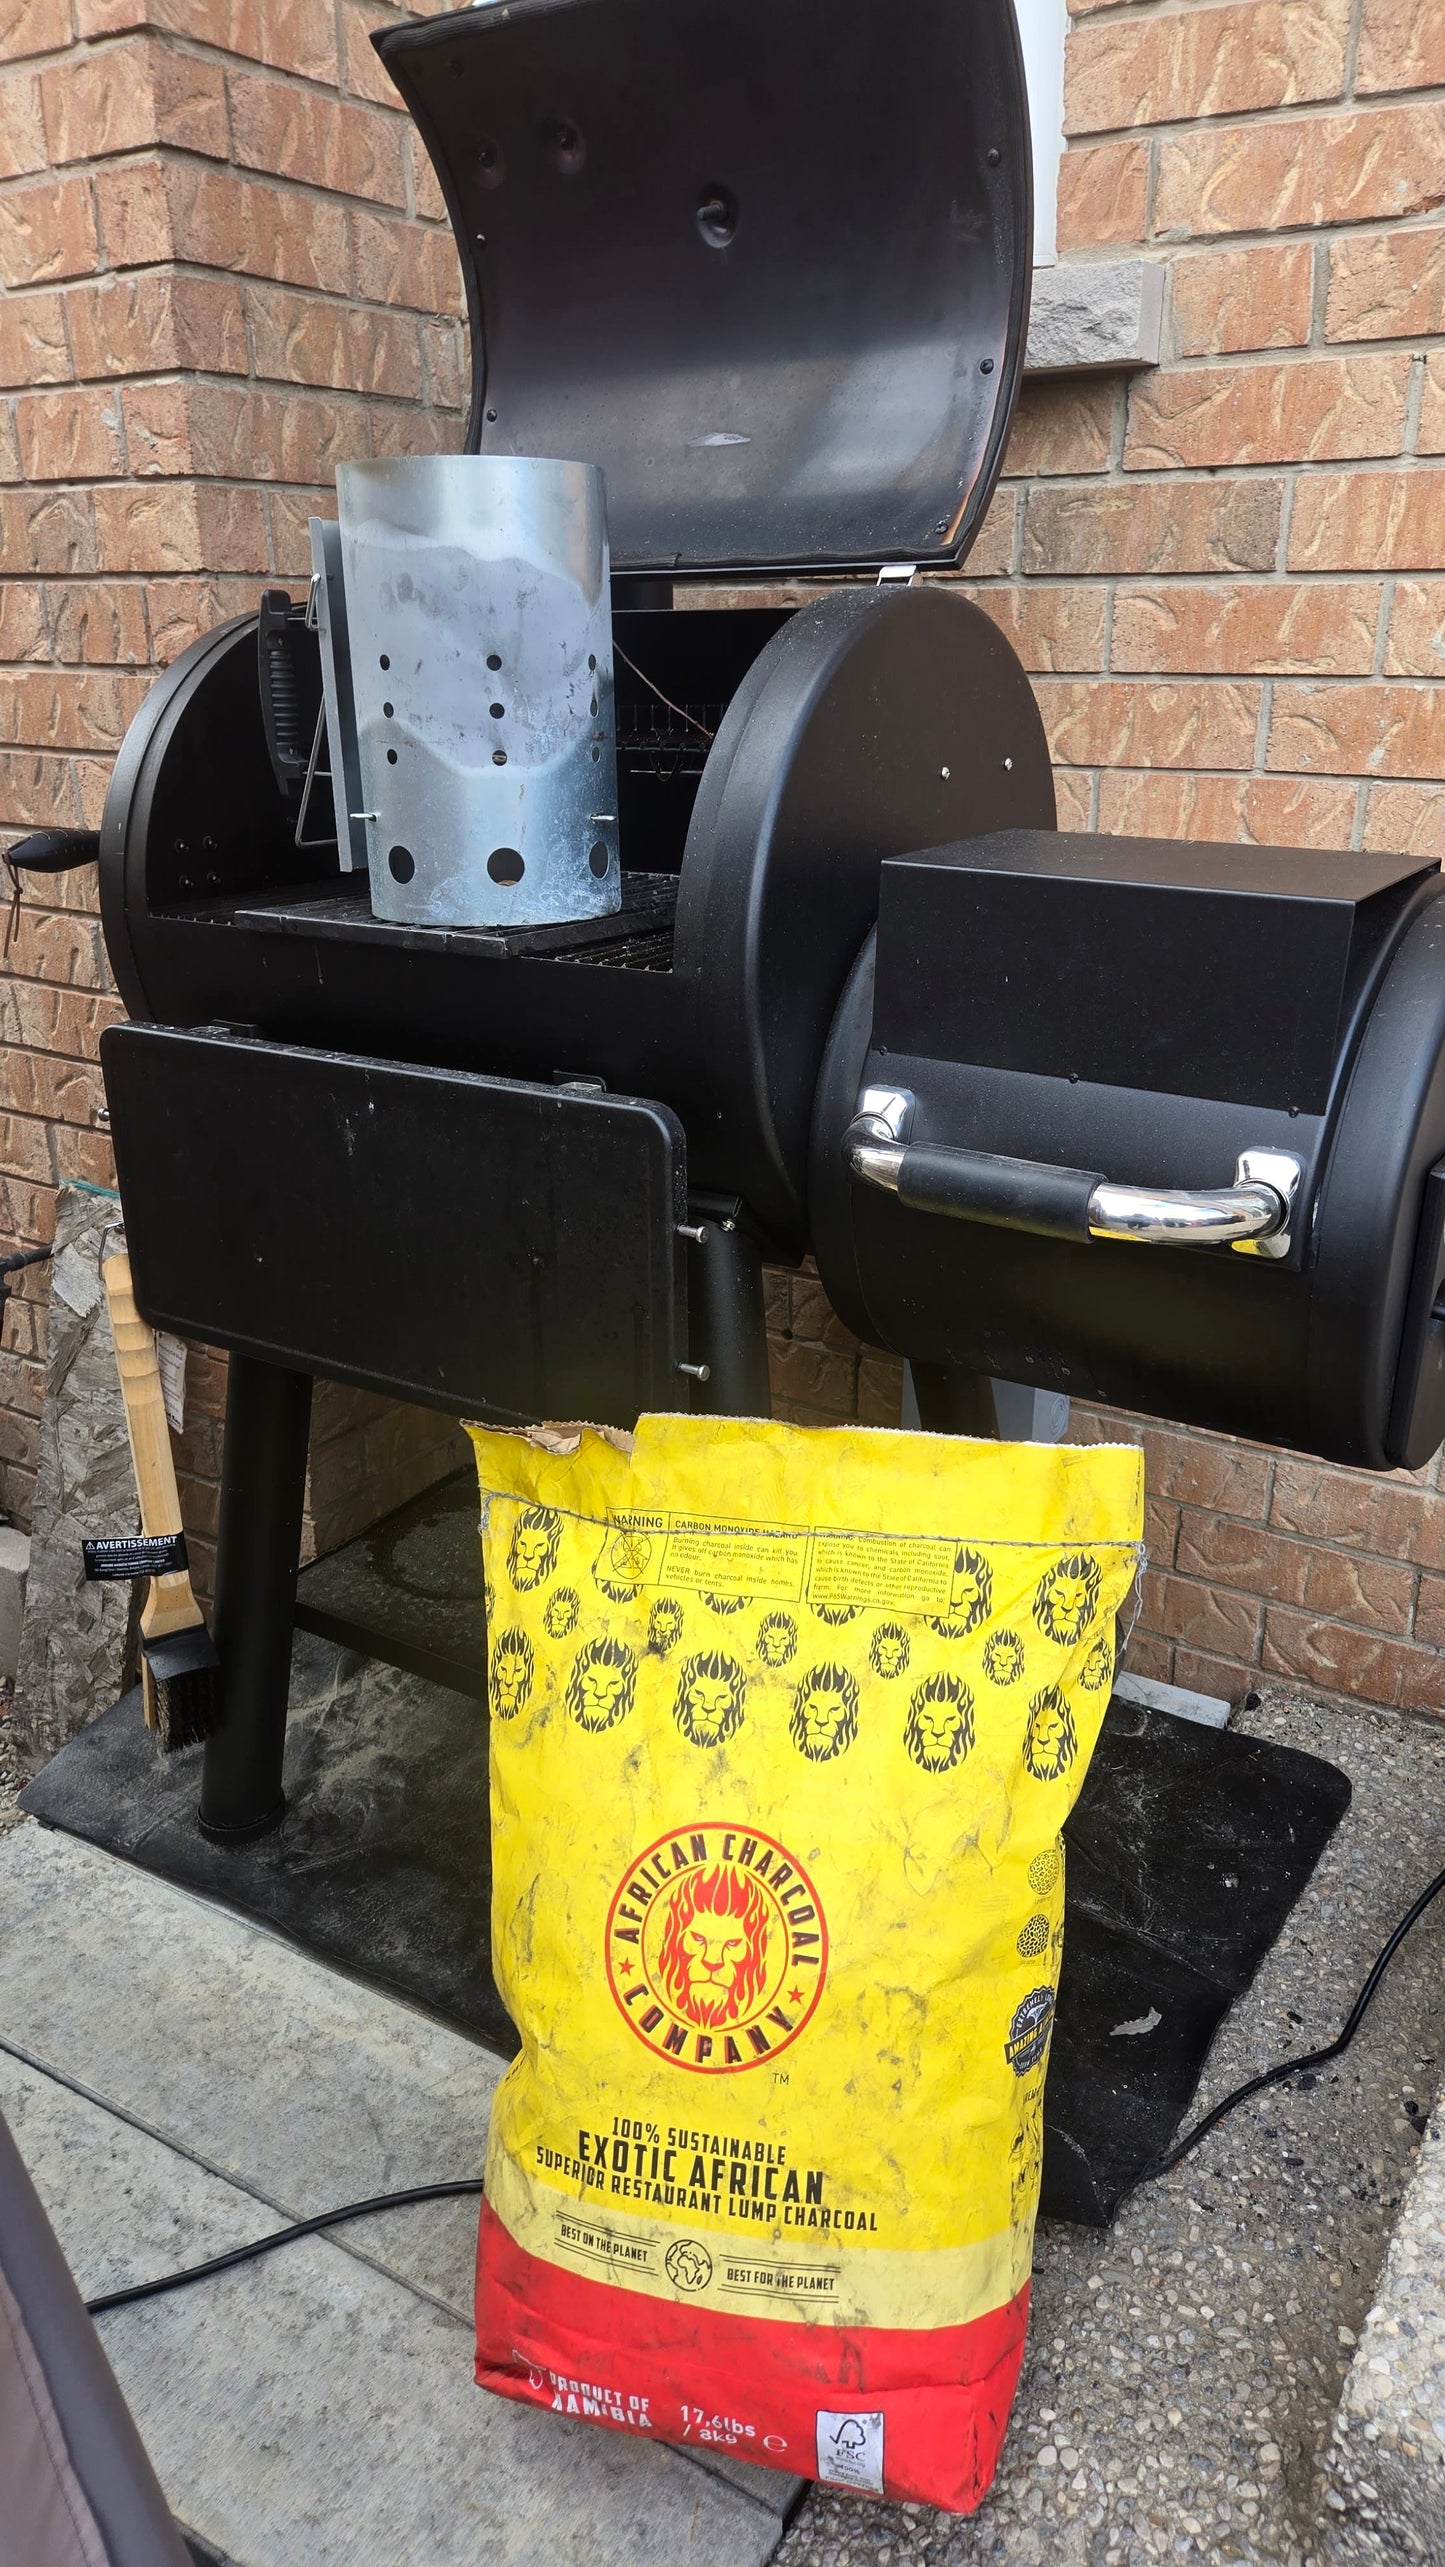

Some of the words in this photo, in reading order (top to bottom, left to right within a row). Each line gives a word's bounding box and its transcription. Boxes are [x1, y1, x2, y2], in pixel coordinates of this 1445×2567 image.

[675, 1520, 711, 1531] CARBON
[96, 1536, 177, 1550] AVERTISSEMENT
[673, 1537, 700, 1546] Burning
[702, 1540, 731, 1550] charcoal
[734, 1543, 754, 1551] inside
[908, 1542, 936, 1551] charcoal
[679, 1546, 696, 1554] gives
[708, 1549, 731, 1557] carbon
[732, 1551, 764, 1560] monoxide
[766, 1554, 785, 1562] which
[786, 1556, 798, 1564] has
[845, 1550, 867, 1560] known
[890, 1557, 907, 1565] State
[916, 1559, 950, 1568] California
[866, 1546, 899, 1556] chemicals
[901, 1550, 931, 1559] including
[665, 1573, 694, 1582] vehicles
[666, 1566, 690, 1574] NEVER
[694, 1569, 711, 1577] burn
[714, 1573, 743, 1582] charcoal
[746, 1576, 767, 1584] inside
[840, 1567, 862, 1575] known
[882, 1573, 900, 1581] State
[906, 1575, 939, 1584] California
[850, 1578, 874, 1587] defects
[903, 1584, 946, 1594] reproductive
[877, 1590, 915, 1599] information
[613, 1833, 707, 1944] AFRICAN
[722, 1833, 820, 1967] CHARCOAL
[624, 1983, 794, 2064] COMPANY
[772, 2072, 790, 2085] TM
[612, 2116, 660, 2144] 100%
[668, 2127, 786, 2165] SUSTAINABLE
[579, 2129, 677, 2183] EXOTIC
[688, 2155, 823, 2205] AFRICAN
[536, 2145, 605, 2190] SUPERIOR
[611, 2174, 722, 2214] RESTAURANT
[728, 2197, 777, 2222] LUMP
[784, 2205, 878, 2231] CHARCOAL
[561, 2223, 581, 2241] BEST
[583, 2232, 594, 2247] ON
[596, 2237, 611, 2253] THE
[613, 2243, 648, 2262] PLANET
[727, 2268, 752, 2282] BEST
[754, 2271, 773, 2286] FOR
[776, 2275, 794, 2288] THE
[796, 2275, 835, 2290] PLANET
[549, 2370, 622, 2406] PRODUCT
[629, 2395, 649, 2412] OF
[699, 2428, 738, 2444] 8kg
[836, 2448, 866, 2461] FSC
